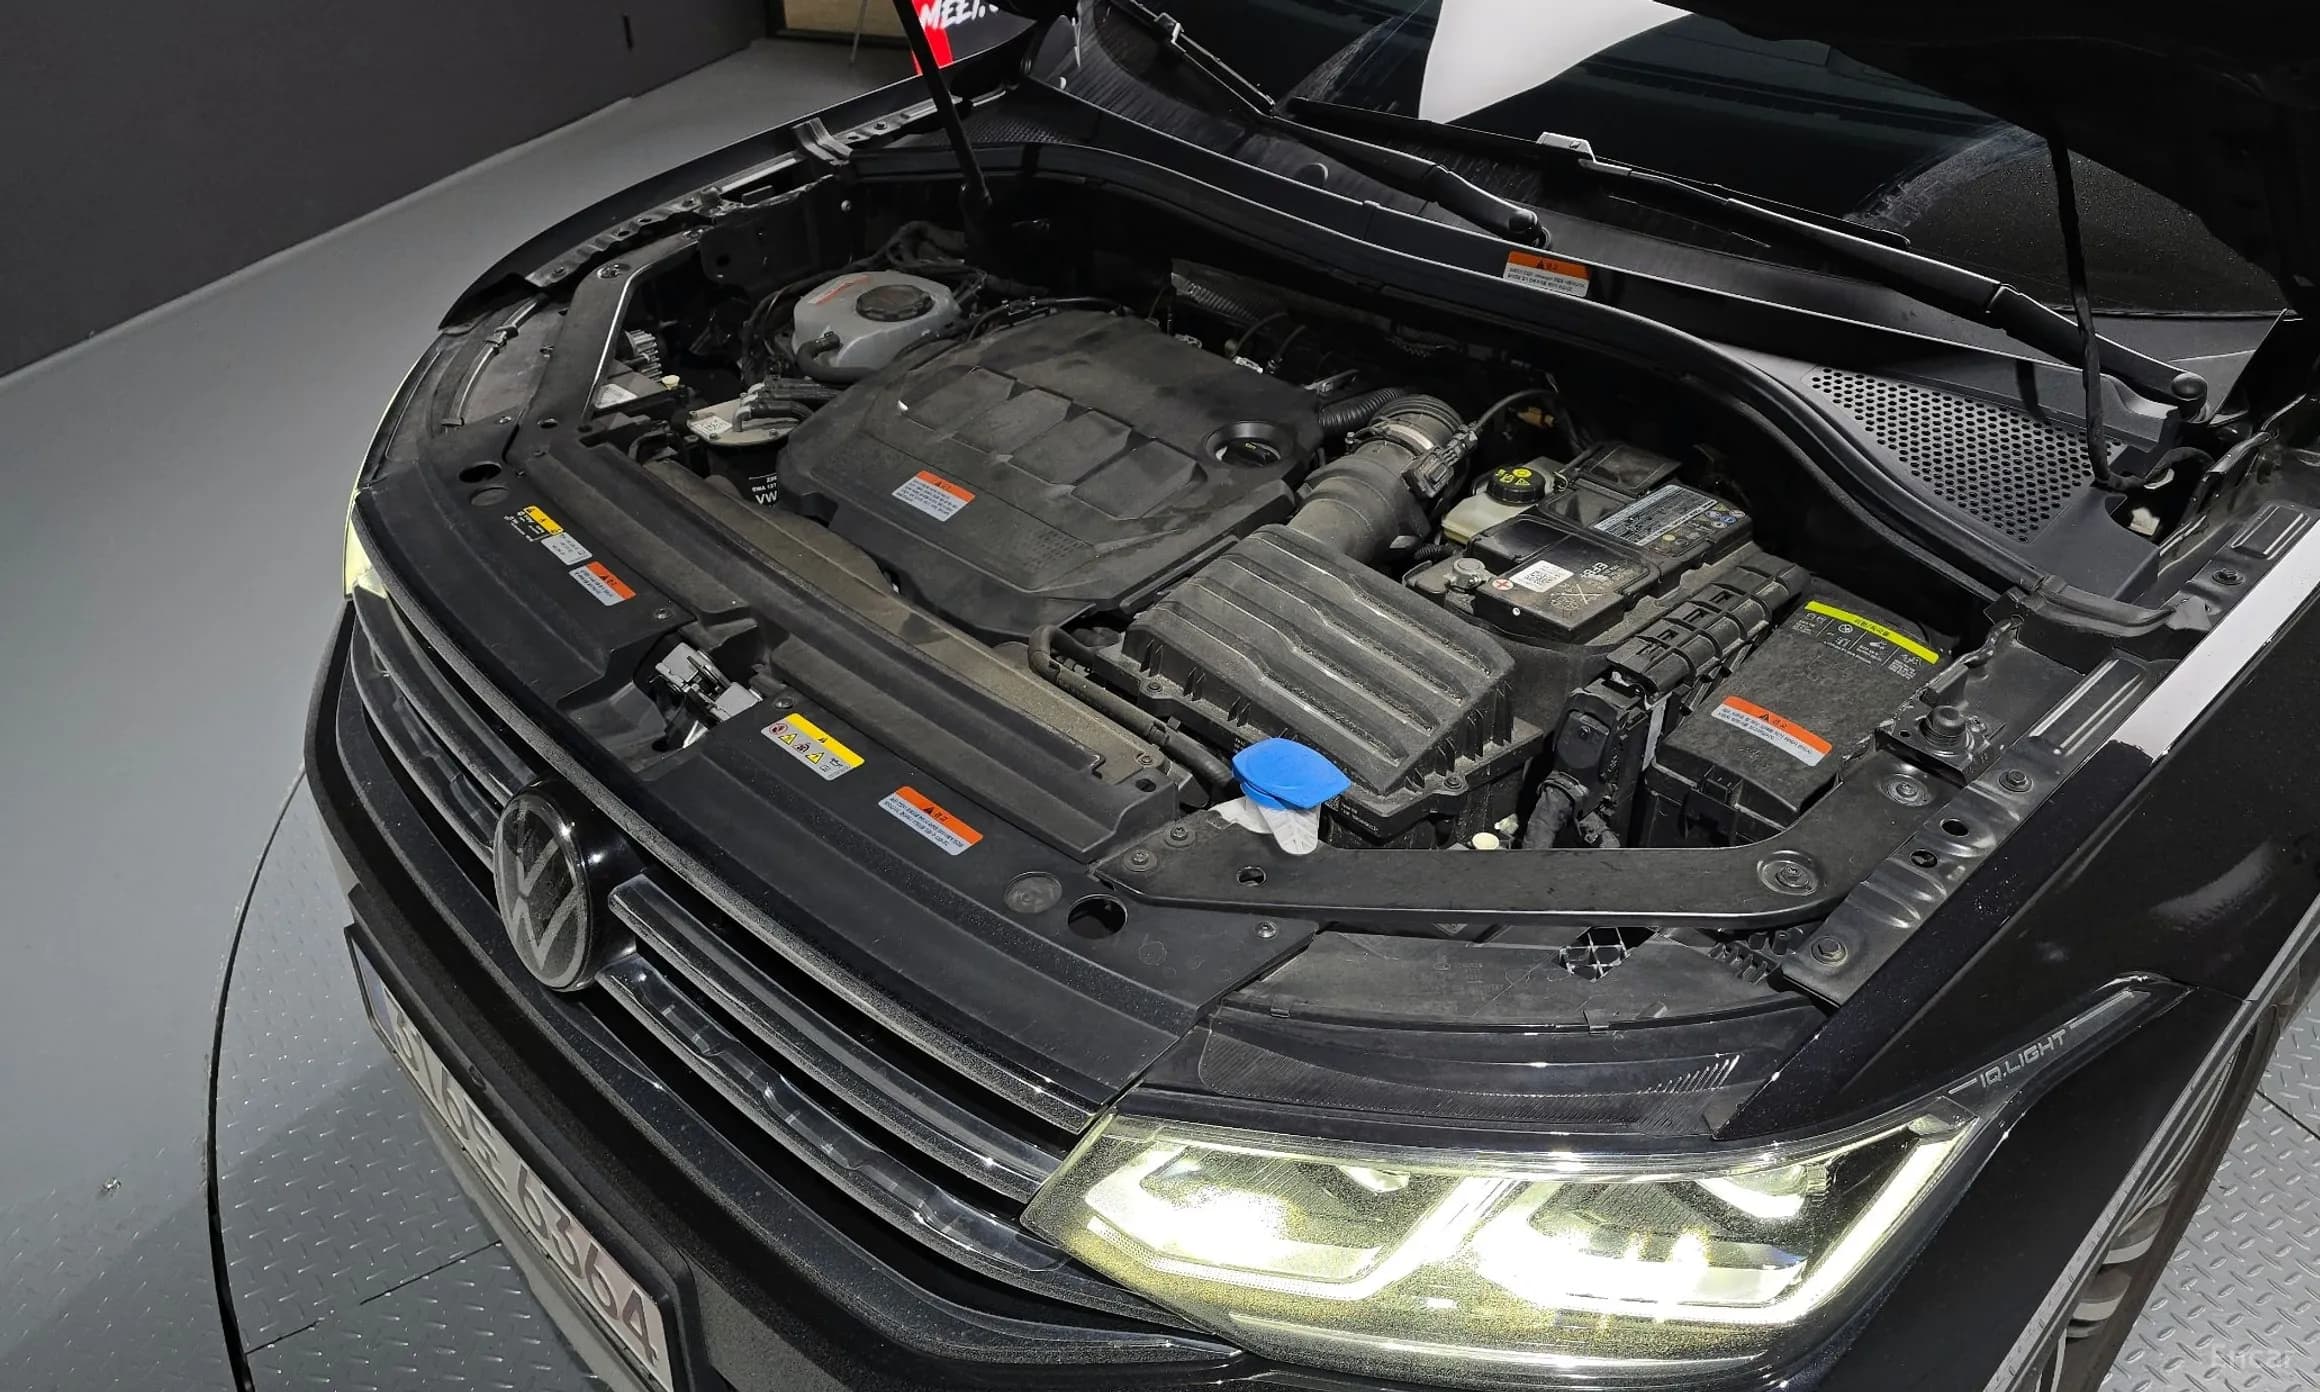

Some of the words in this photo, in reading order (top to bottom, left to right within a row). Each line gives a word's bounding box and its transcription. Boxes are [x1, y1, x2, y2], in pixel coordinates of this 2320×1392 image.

[755, 490, 777, 504] VW
[1979, 1028, 2066, 1088] IQ.LIGHT
[516, 1163, 660, 1368] 6364
